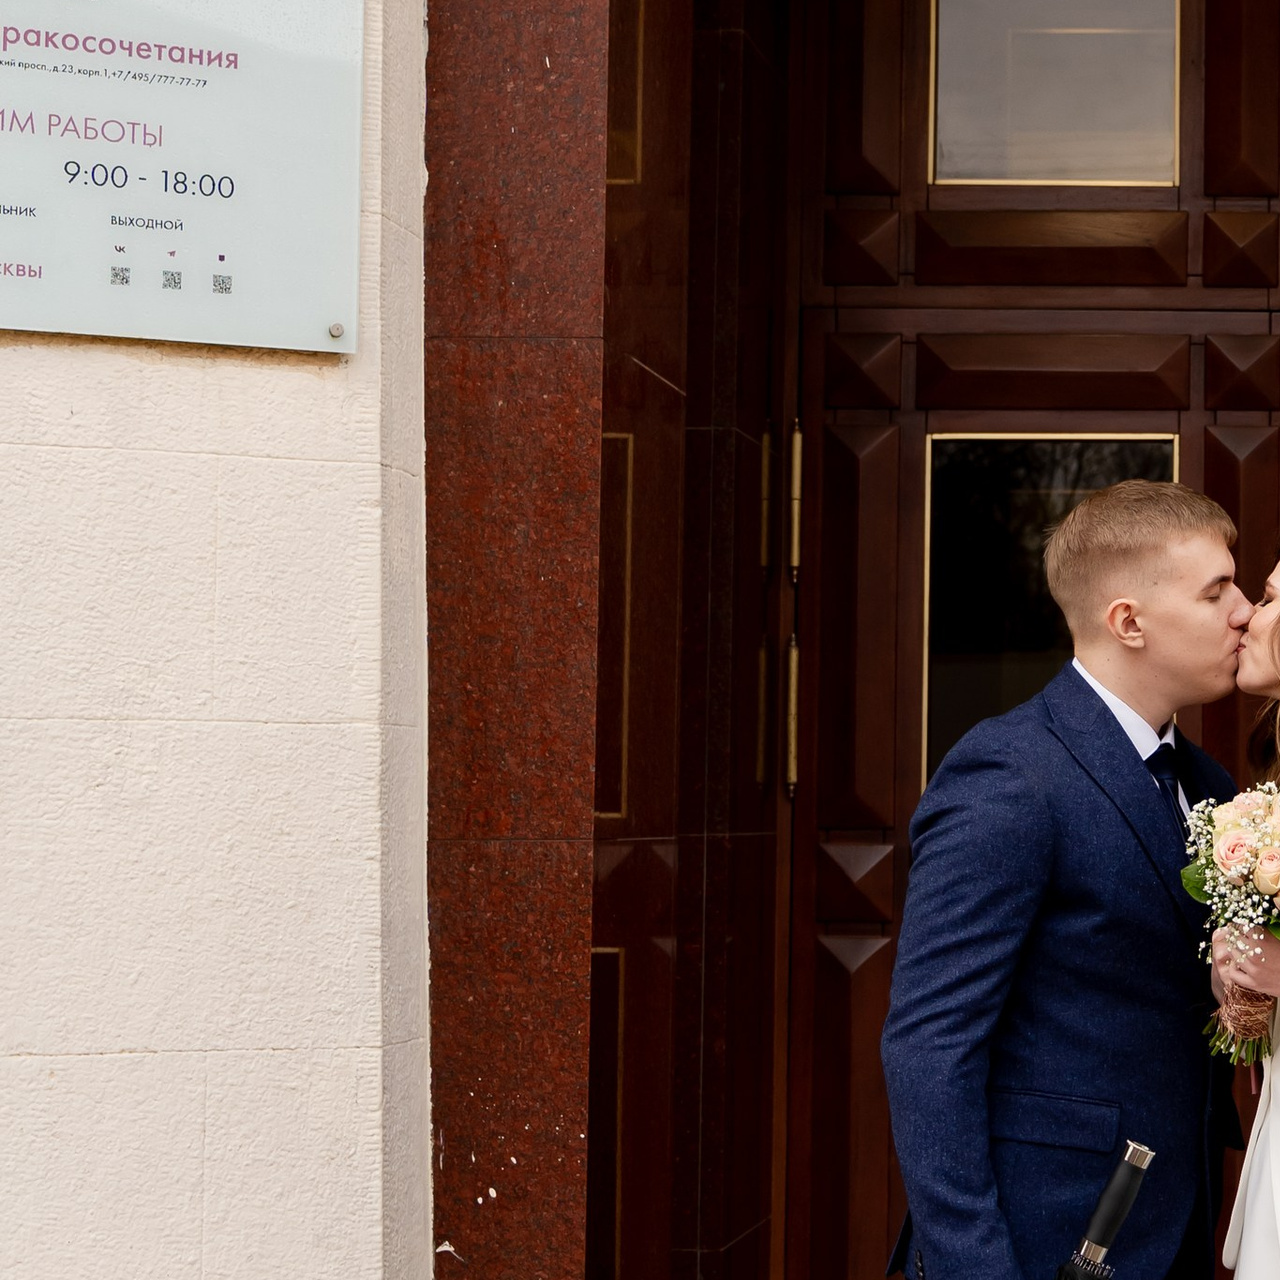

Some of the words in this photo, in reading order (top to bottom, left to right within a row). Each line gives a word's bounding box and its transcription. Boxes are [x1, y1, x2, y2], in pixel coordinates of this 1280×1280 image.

[48, 114, 163, 148] РАБОТЫ
[64, 160, 128, 188] 9:00
[161, 170, 235, 198] 18:00
[110, 215, 184, 231] ВЫХОДНОЙ
